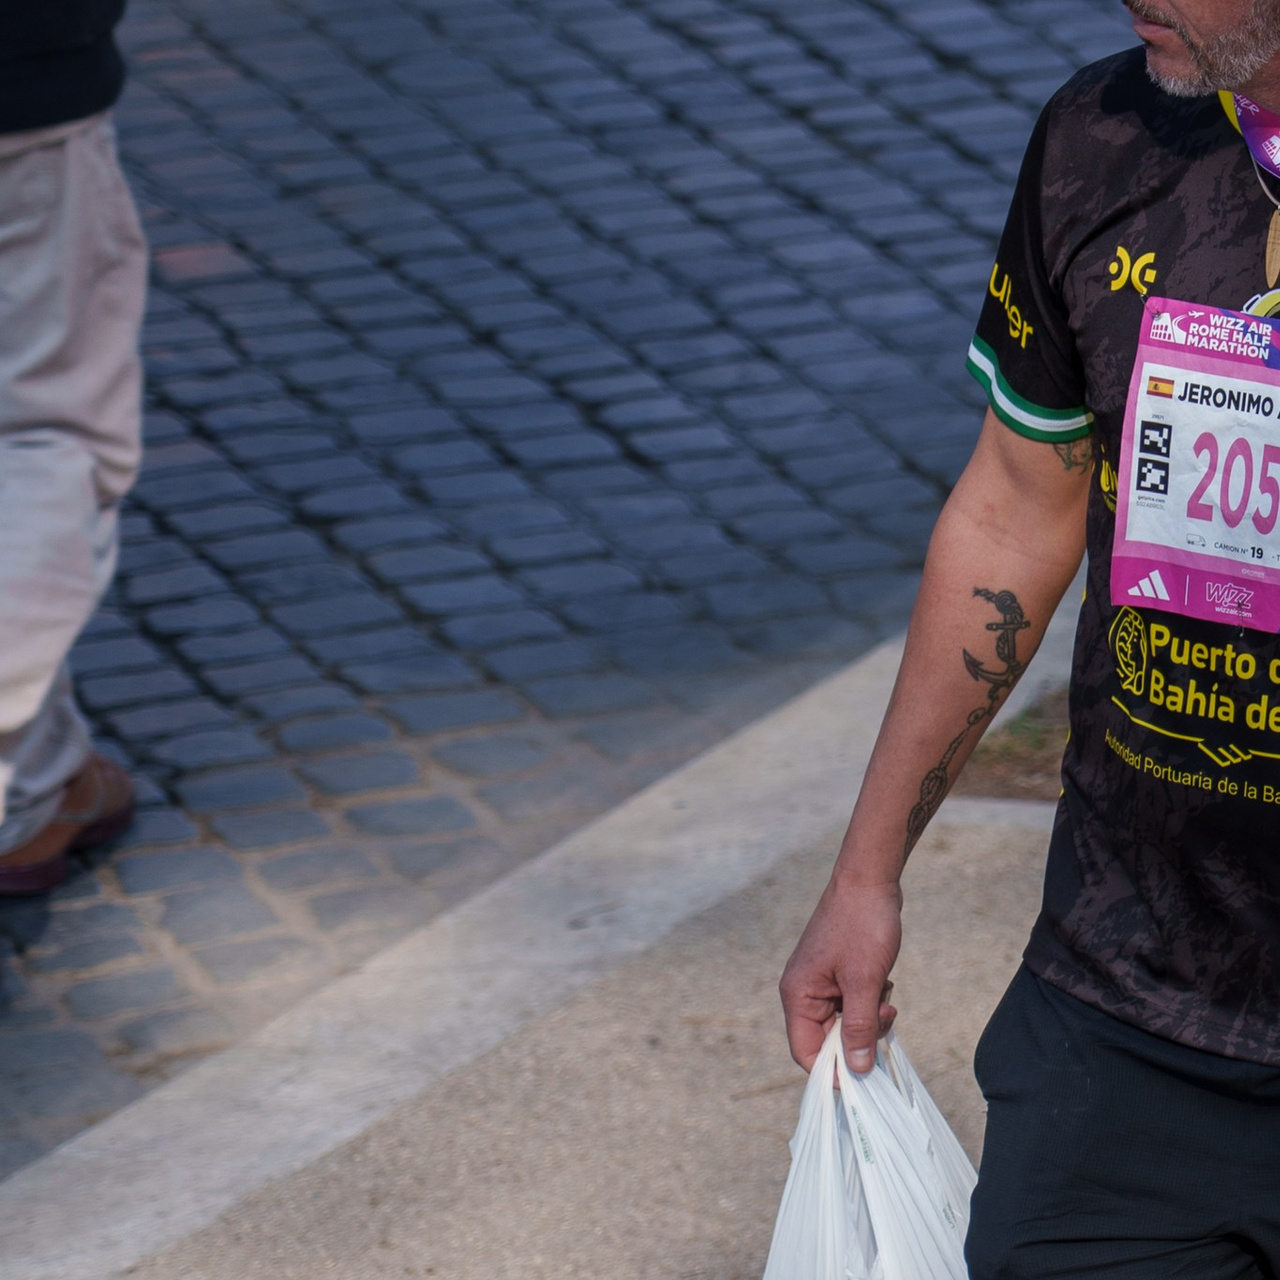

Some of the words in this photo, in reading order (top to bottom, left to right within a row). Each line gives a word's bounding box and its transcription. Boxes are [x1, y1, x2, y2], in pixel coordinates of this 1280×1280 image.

[1188, 322, 1230, 340] ROME
[1232, 330, 1271, 347] HALF
[1209, 313, 1245, 331] WIZZ
[1247, 321, 1272, 336] AIR
[1186, 334, 1269, 360] MARATHON
[1177, 381, 1274, 417] JERONIMO
[1213, 542, 1240, 554] CAMION
[1250, 546, 1264, 559] 19
[1149, 623, 1256, 680] Puerto
[1149, 669, 1235, 723] Bahía
[1104, 728, 1142, 771] Autoridad
[1143, 758, 1213, 791] Portuaria
[1217, 776, 1239, 796] de
[1243, 781, 1258, 800] la
